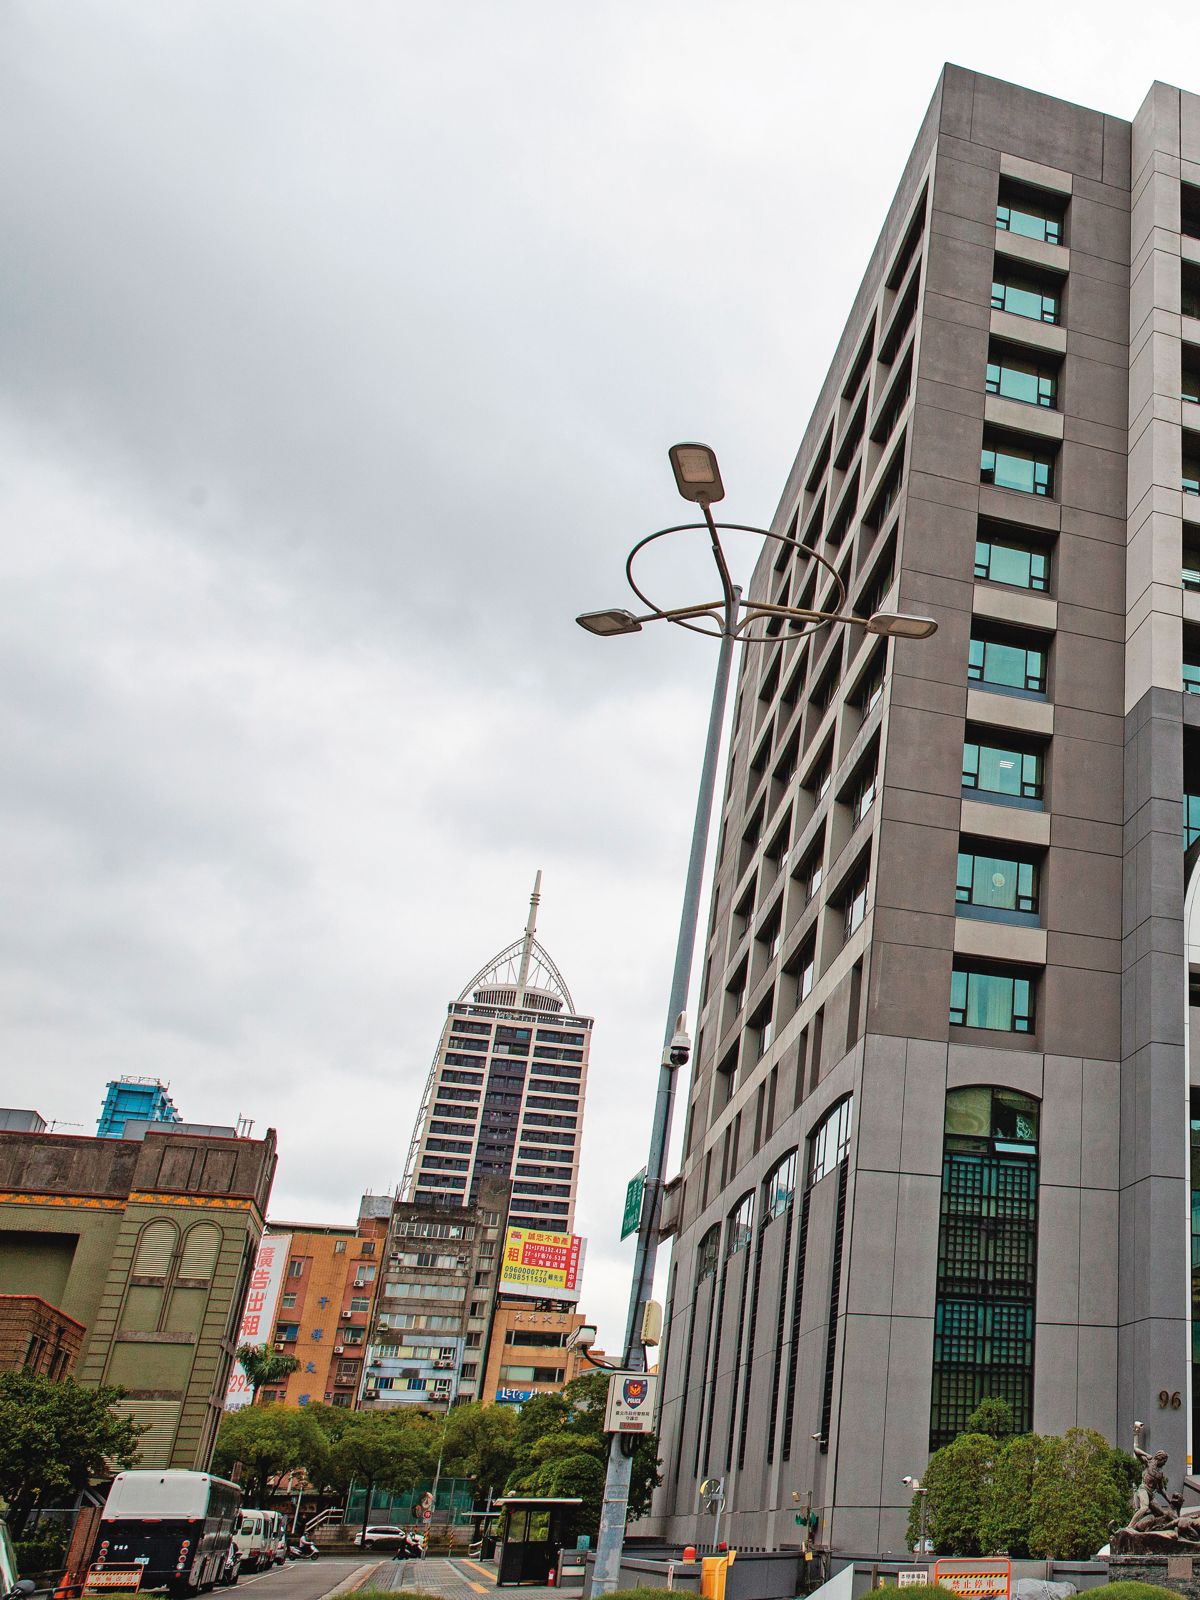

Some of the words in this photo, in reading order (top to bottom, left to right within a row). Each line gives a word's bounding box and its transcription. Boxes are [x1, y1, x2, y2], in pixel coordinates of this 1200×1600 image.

[508, 1247, 520, 1262] 租
[241, 1247, 275, 1336] 廣告出租
[501, 1386, 525, 1400] LET'S
[1159, 1390, 1181, 1409] 96
[952, 1579, 994, 1589] 禁止停車
